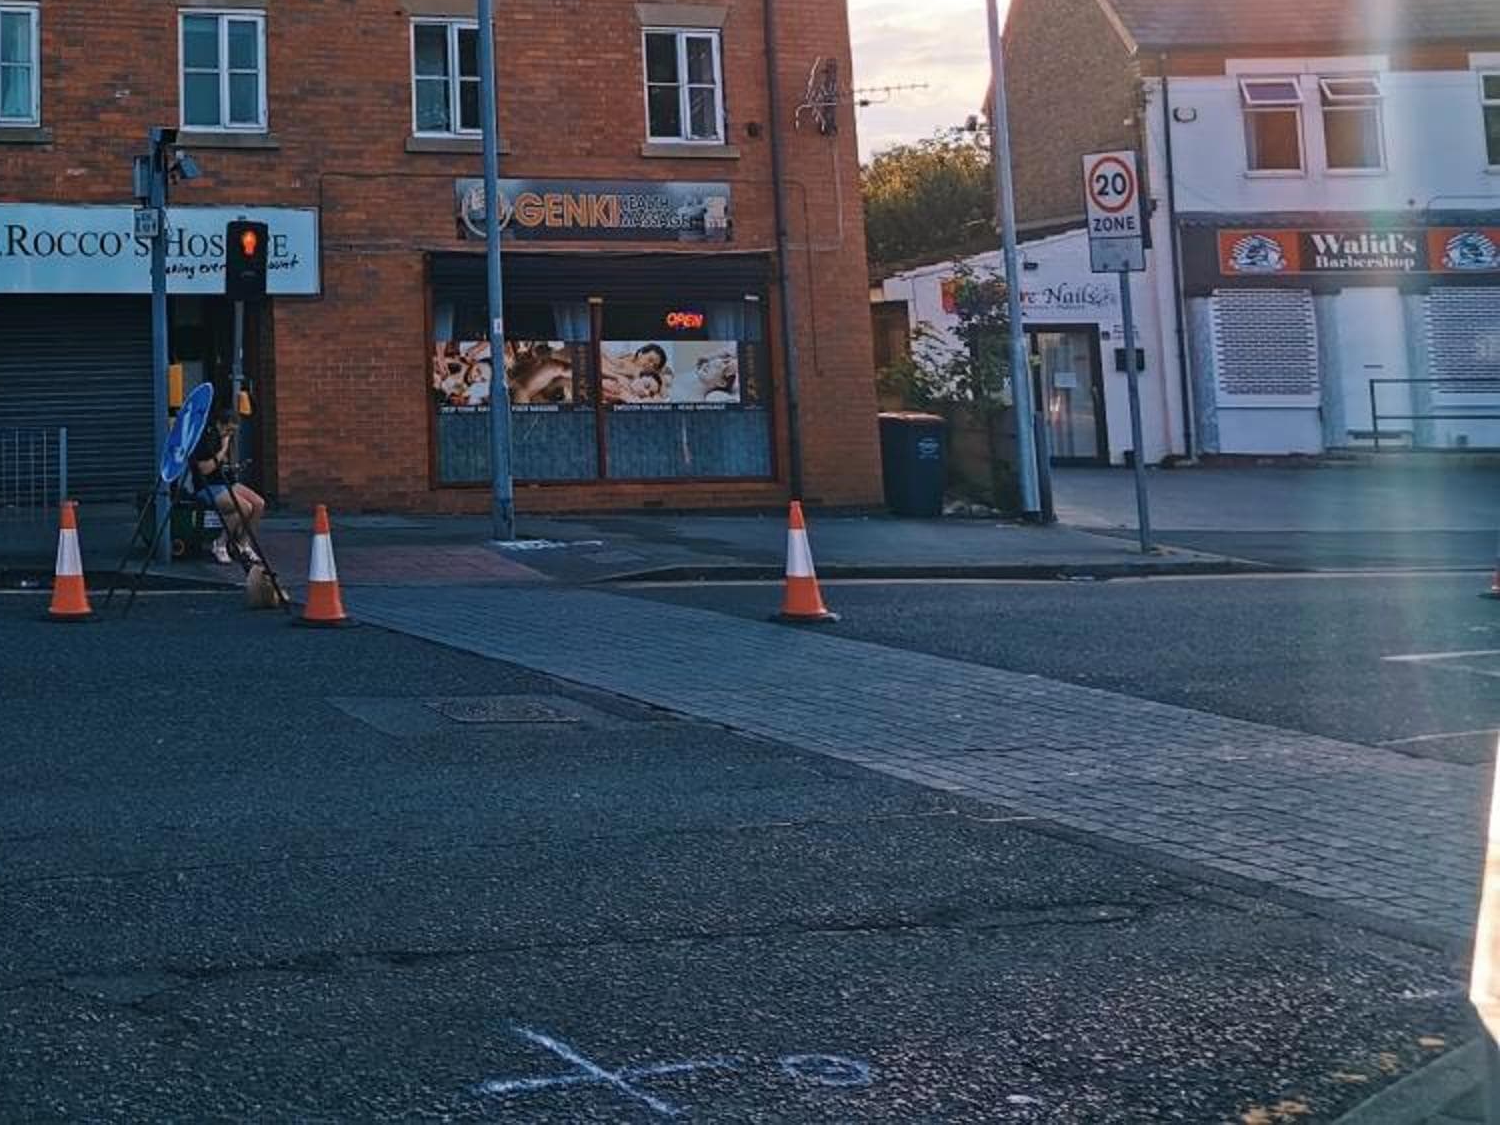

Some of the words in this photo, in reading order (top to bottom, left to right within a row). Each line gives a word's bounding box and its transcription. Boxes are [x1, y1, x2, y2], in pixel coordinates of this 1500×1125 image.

[1095, 173, 1127, 196] 20
[515, 192, 620, 227] GENKI
[1093, 216, 1136, 232] ZONE
[164, 228, 288, 258] HOSE
[1311, 233, 1418, 255] Walid's
[1315, 255, 1416, 271] Barbershop
[666, 311, 704, 328] OPEN
